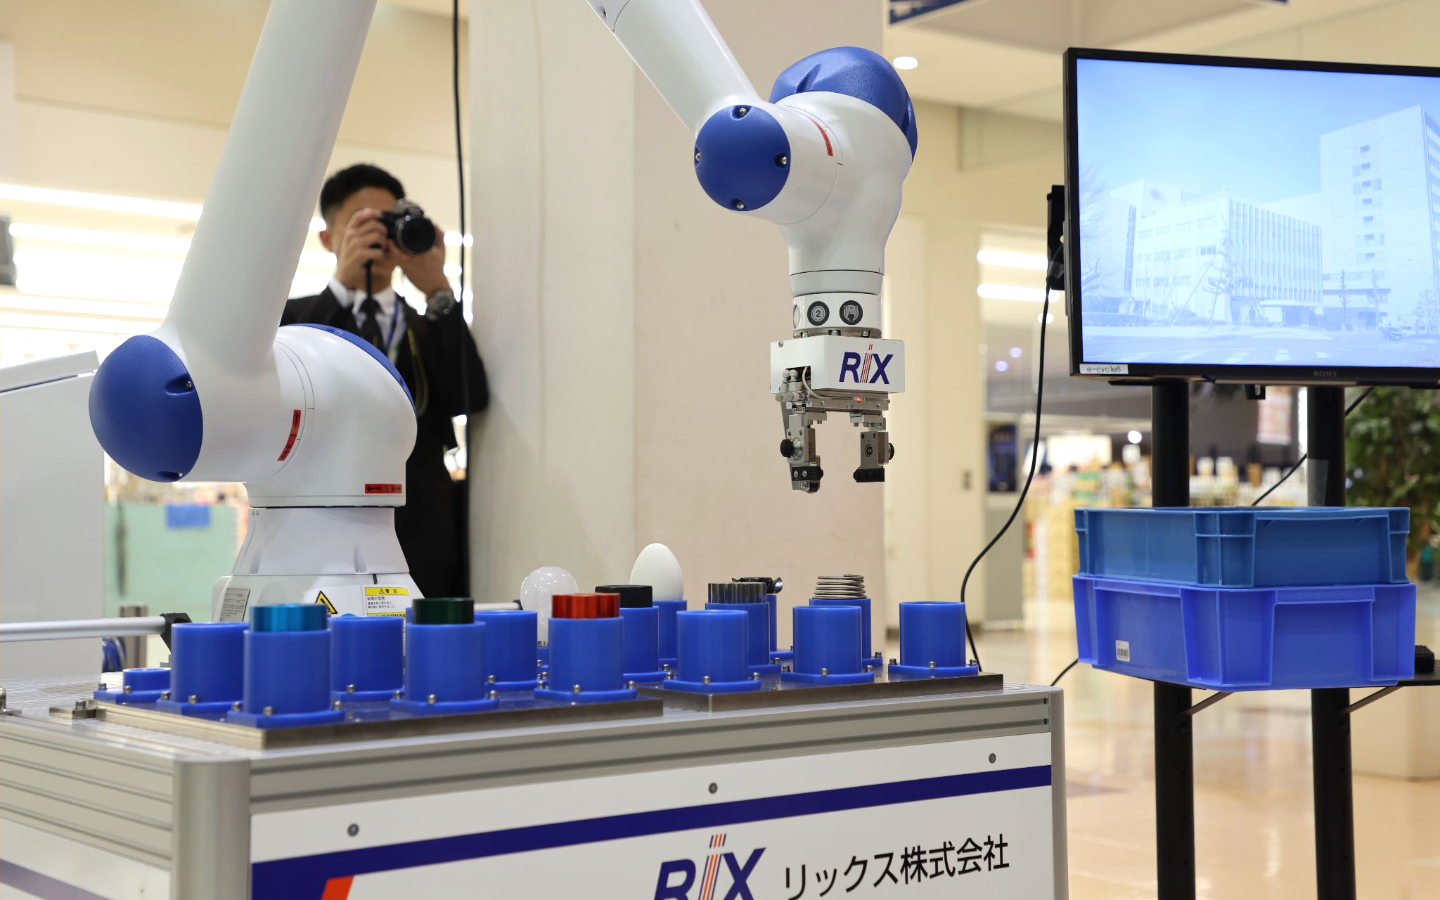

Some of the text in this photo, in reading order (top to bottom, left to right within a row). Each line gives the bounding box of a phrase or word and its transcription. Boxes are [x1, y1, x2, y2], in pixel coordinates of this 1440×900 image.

[785, 833, 1010, 900] リックス株式会社
